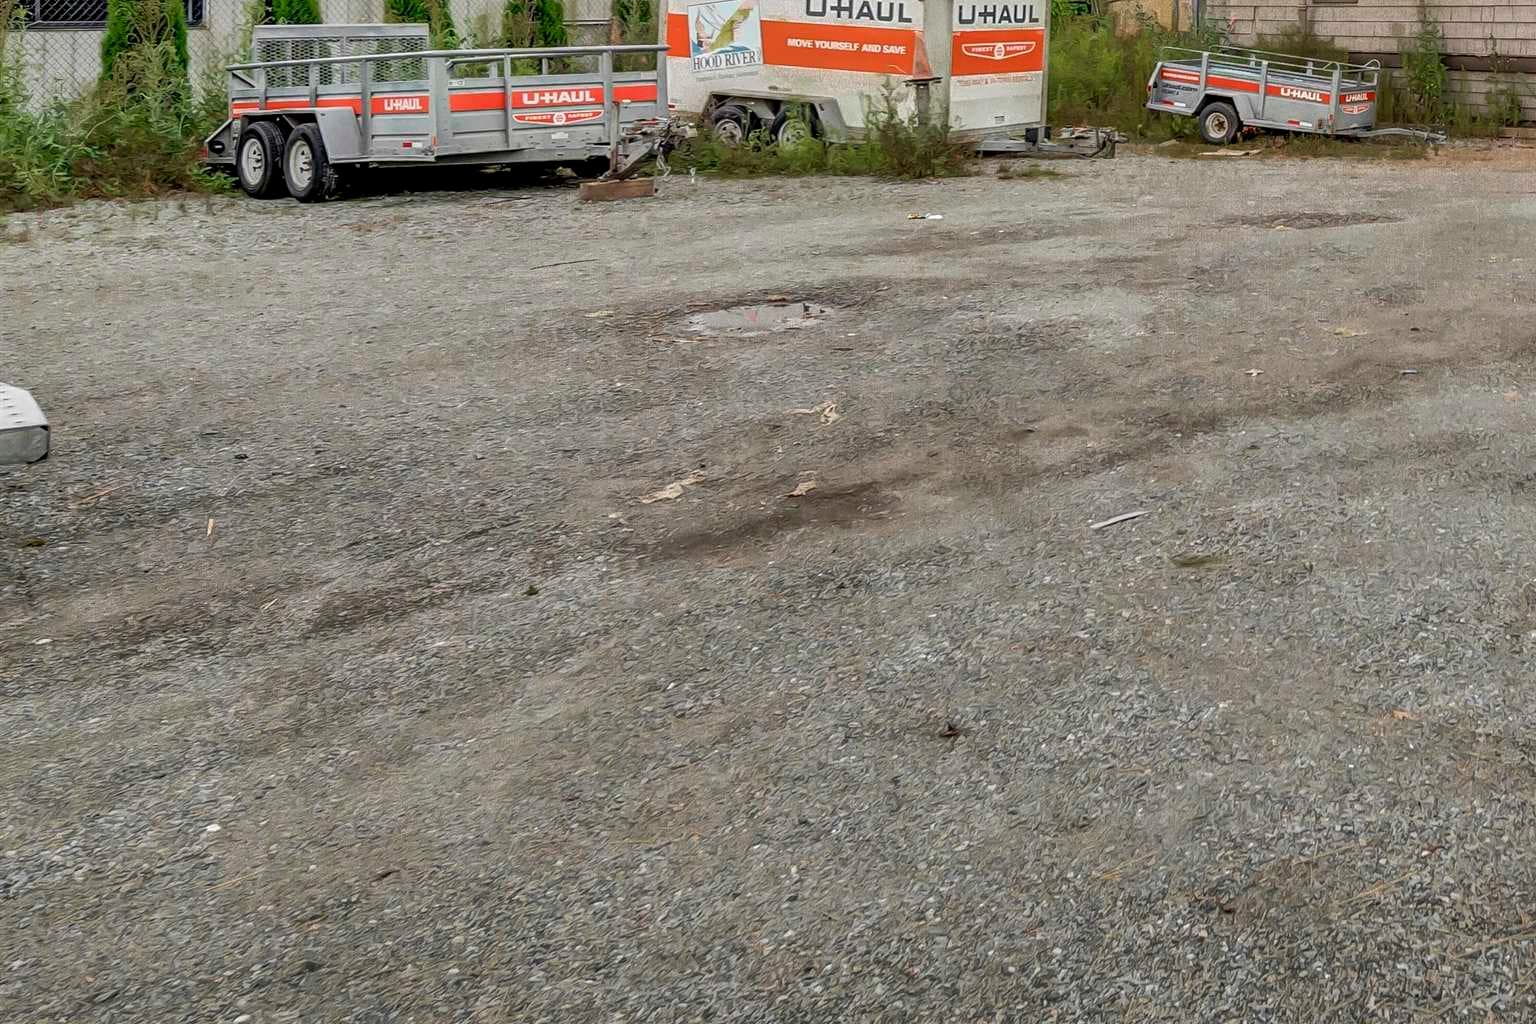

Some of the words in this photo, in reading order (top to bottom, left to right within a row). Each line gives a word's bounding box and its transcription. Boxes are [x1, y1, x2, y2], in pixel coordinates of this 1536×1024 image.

[958, 4, 1040, 24] U-HAUL
[787, 38, 813, 49] MOVE
[815, 40, 860, 52] YOURSELF
[861, 44, 882, 53] AND
[883, 45, 907, 55] SAVE
[693, 55, 722, 70] HOOD
[725, 50, 756, 66] RIVER
[522, 90, 596, 105] U-HAUL
[1280, 87, 1322, 101] U-HAUL
[383, 98, 423, 112] U-HAUL
